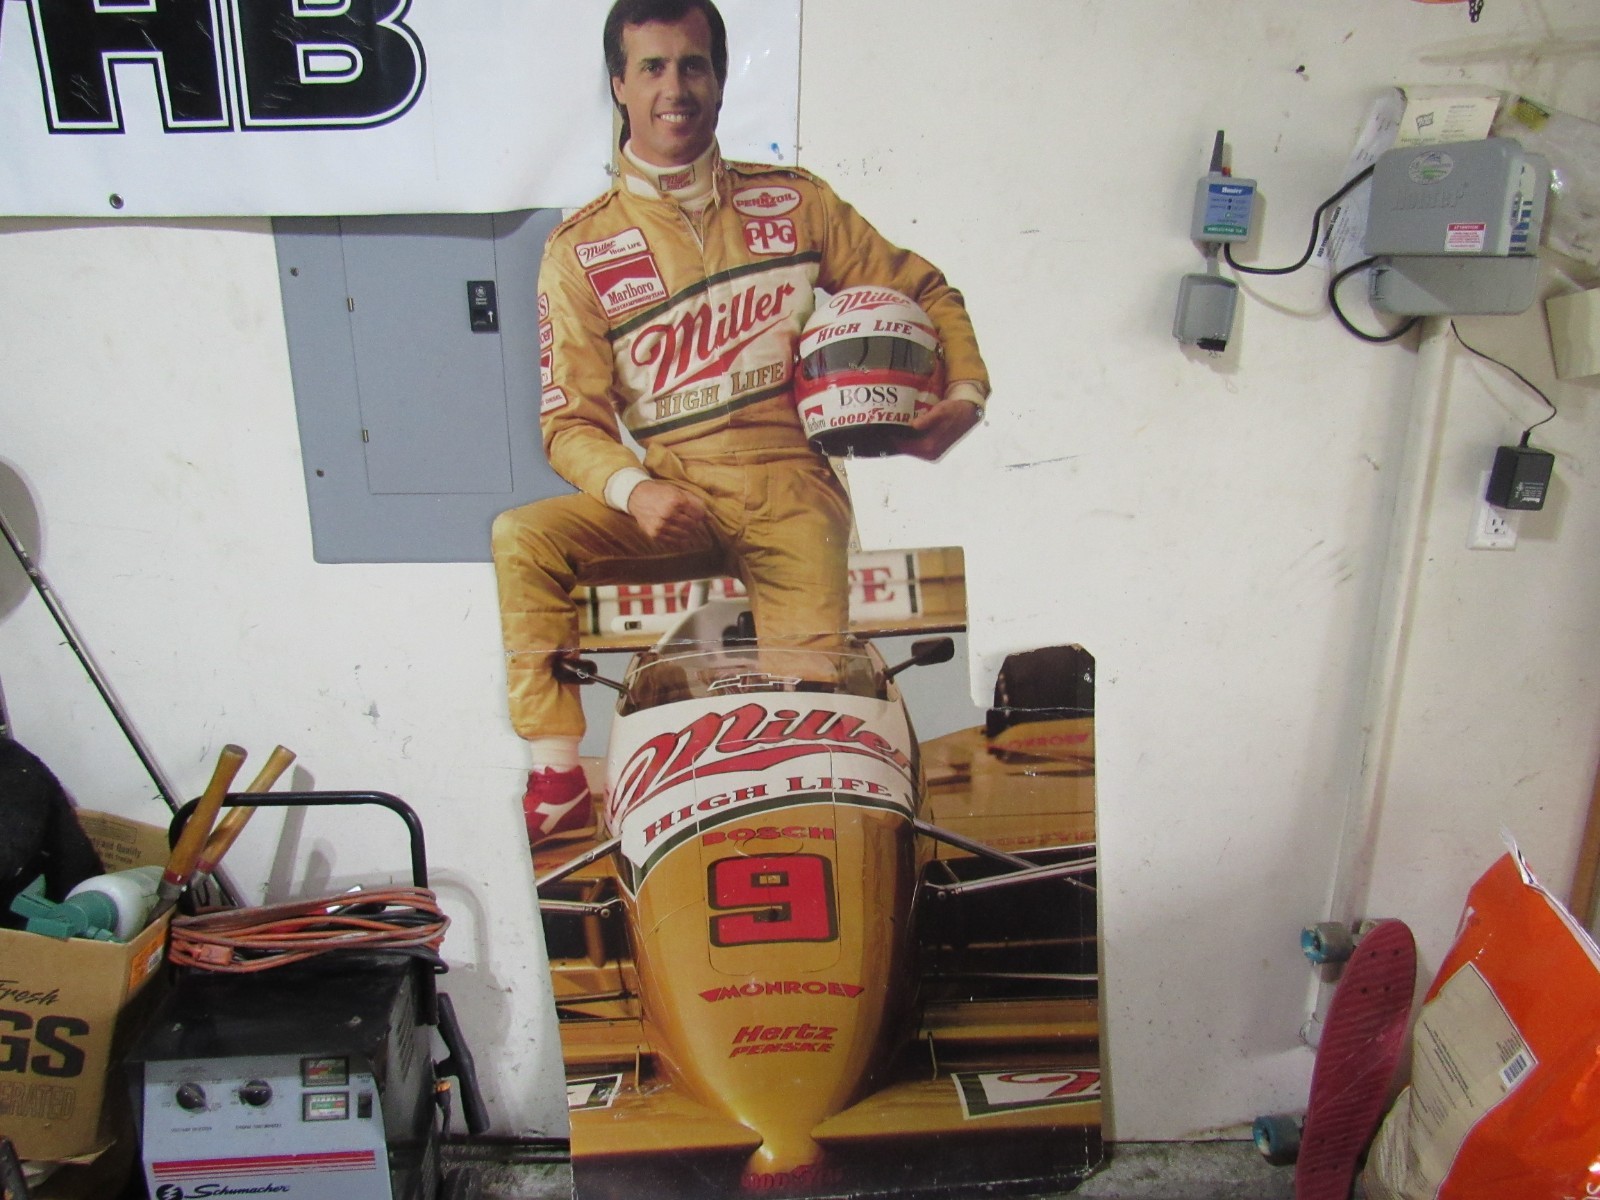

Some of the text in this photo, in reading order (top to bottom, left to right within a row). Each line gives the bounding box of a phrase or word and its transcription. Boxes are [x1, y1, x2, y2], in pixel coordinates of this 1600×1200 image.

[750, 219, 796, 249] PPG
[579, 240, 616, 263] Miller
[607, 281, 654, 306] Marlboro
[631, 282, 795, 394] Miller
[816, 319, 913, 344] HIGH LIFE
[655, 361, 784, 421] HIGH LIFE
[839, 386, 899, 407] BOSS
[611, 702, 909, 818] Miller
[643, 776, 893, 848] HIGH LIFE
[702, 826, 835, 847] BOSCH
[707, 853, 839, 947] 9
[717, 981, 845, 1001] MONROE
[732, 1023, 839, 1044] Hertz
[729, 1041, 836, 1059] PENSKE
[184, 1183, 291, 1199] Schumacher
